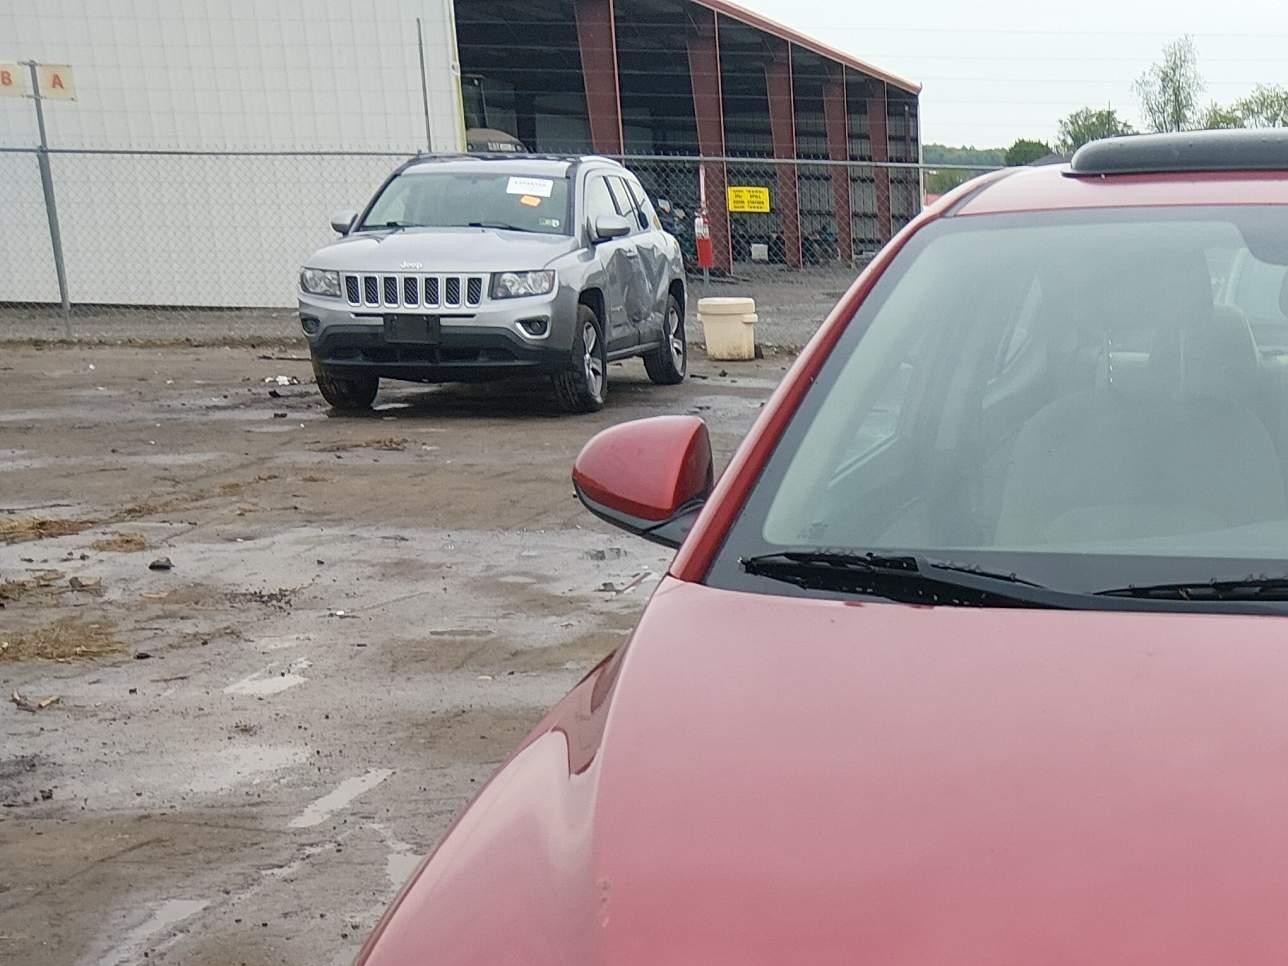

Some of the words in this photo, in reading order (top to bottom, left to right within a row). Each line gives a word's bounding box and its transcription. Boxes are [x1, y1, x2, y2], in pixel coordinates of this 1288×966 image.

[0, 70, 13, 86] B
[51, 73, 65, 89] A
[399, 259, 423, 271] Jeep
